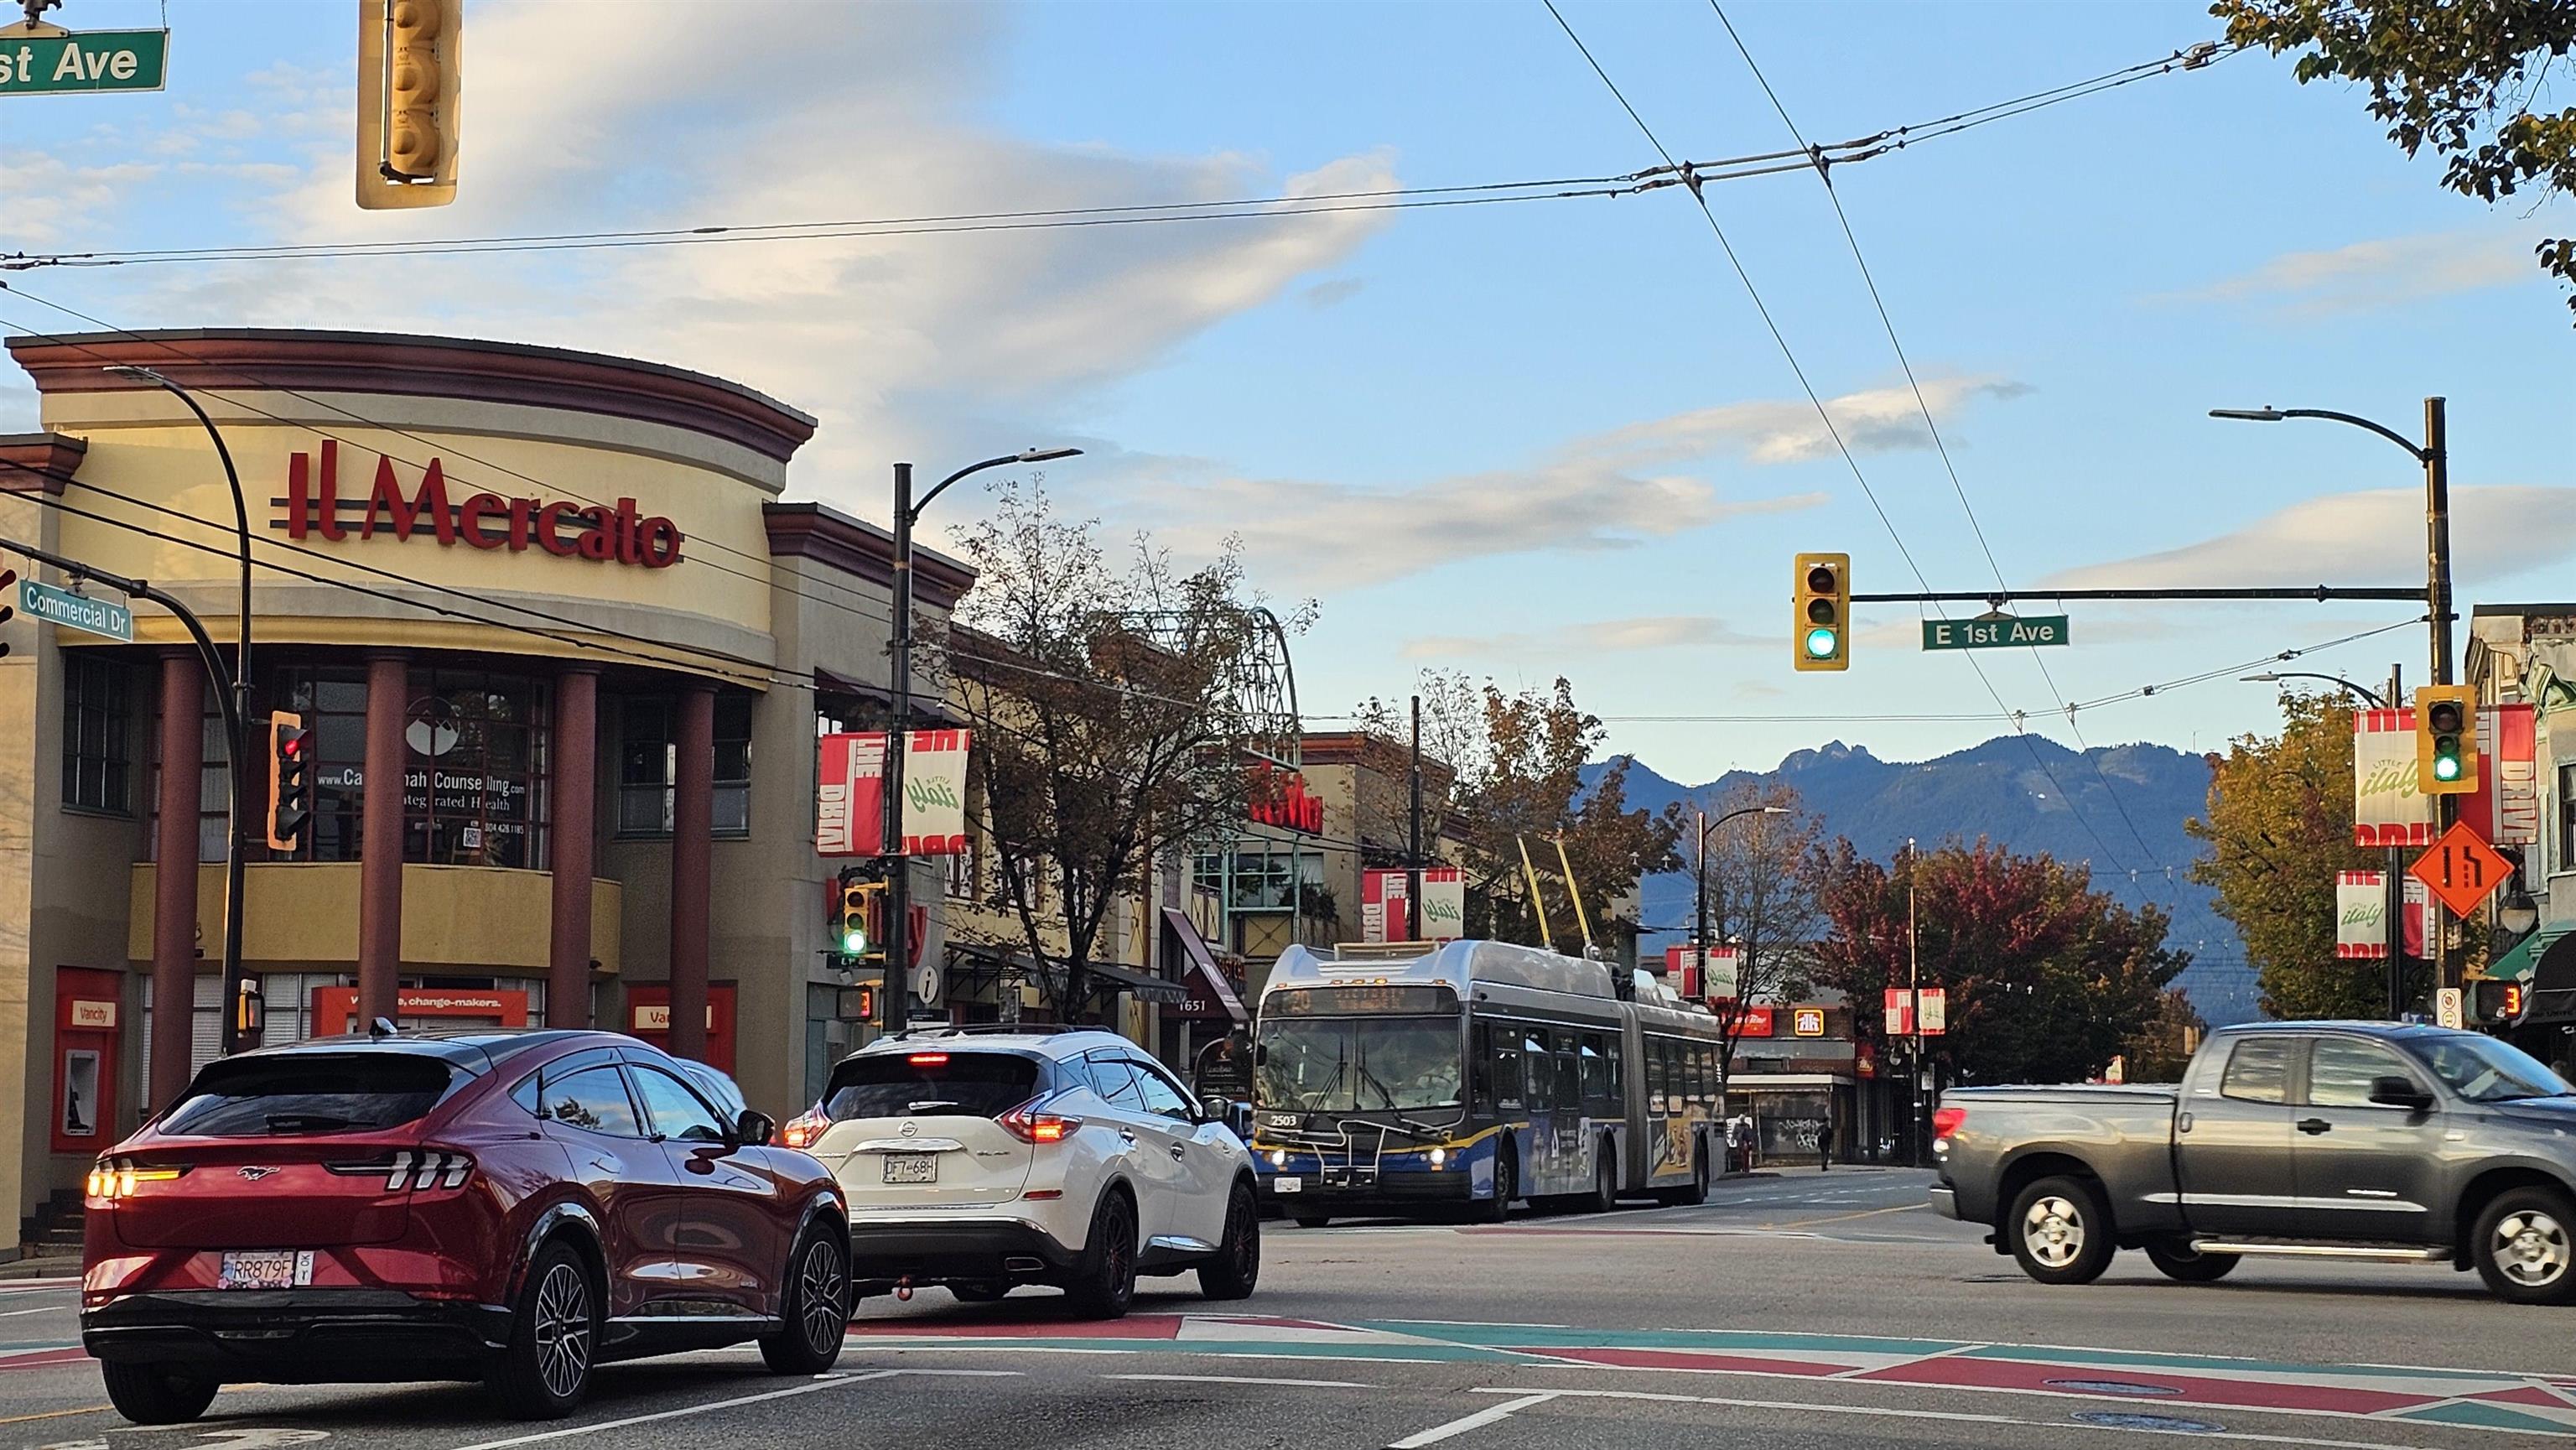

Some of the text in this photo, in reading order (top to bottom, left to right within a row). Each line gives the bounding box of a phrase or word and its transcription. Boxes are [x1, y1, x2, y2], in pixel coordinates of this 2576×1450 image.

[52, 43, 138, 81] Ave
[288, 439, 681, 569] Il Mercato
[26, 586, 126, 633] Commercial Dr
[1935, 622, 2054, 645] E 1st Ave
[2341, 903, 2383, 928] italy
[1180, 1000, 1206, 1011] 1651
[2506, 987, 2519, 1014] 3
[80, 1006, 107, 1024] Vancity
[1271, 1115, 1297, 1126] 2503
[233, 1260, 292, 1280] RR879F
